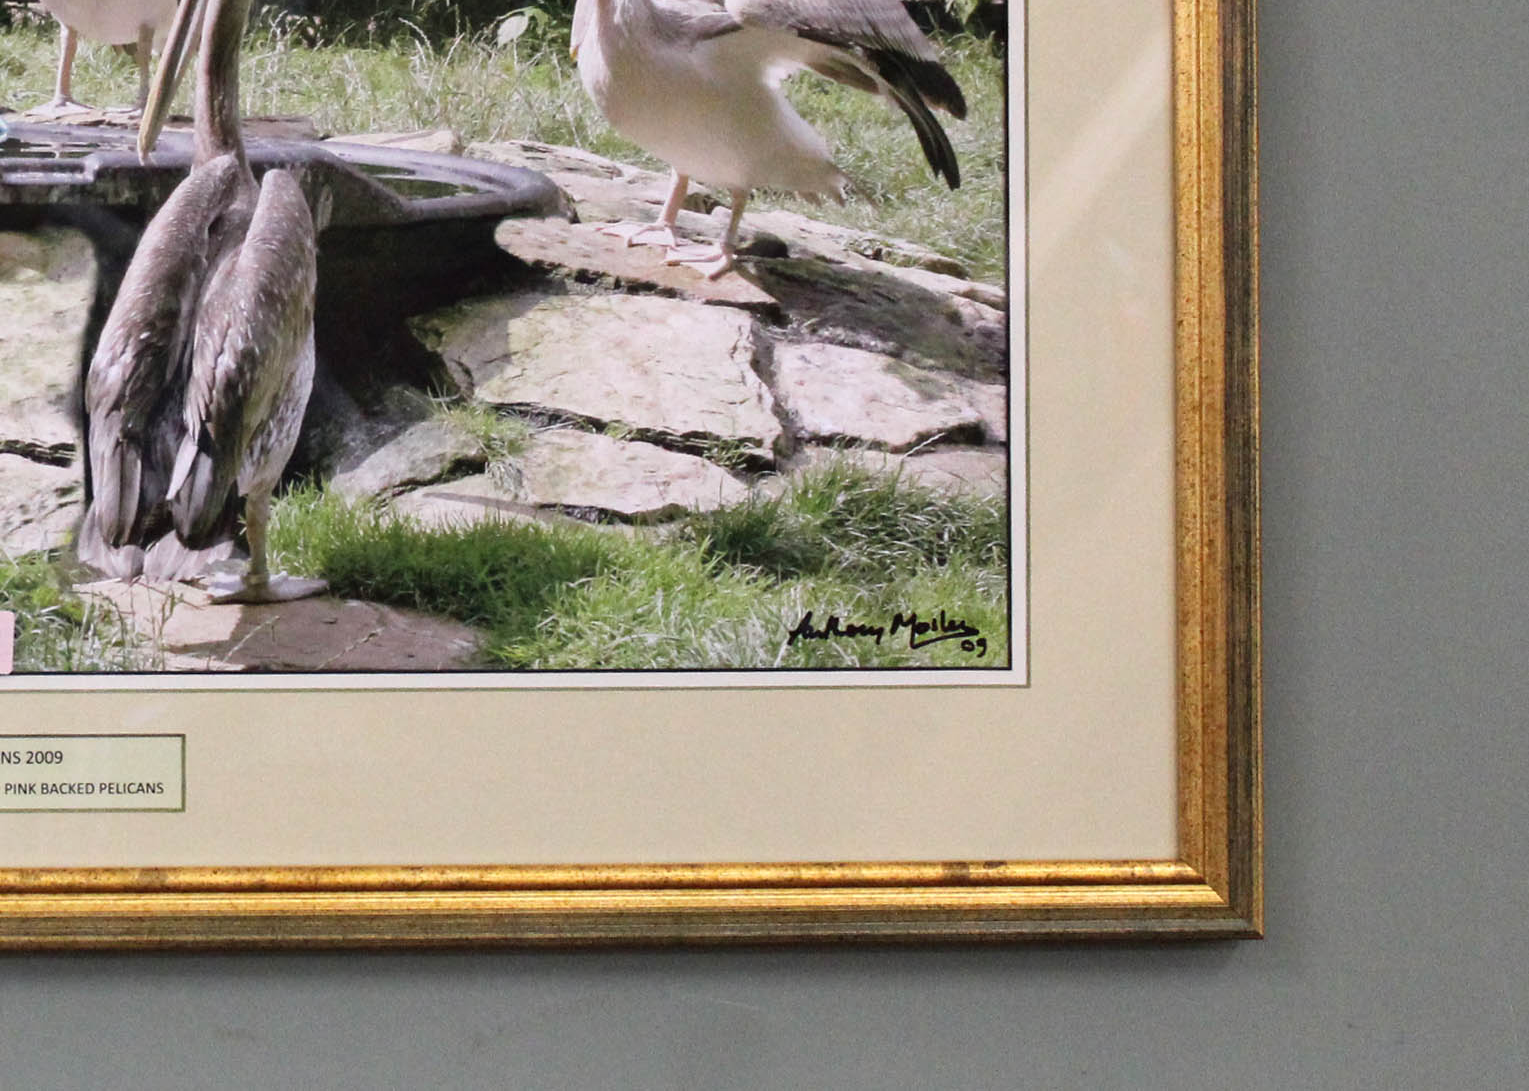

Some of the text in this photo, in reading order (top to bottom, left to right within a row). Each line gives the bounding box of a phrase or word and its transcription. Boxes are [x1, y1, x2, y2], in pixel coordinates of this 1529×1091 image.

[960, 636, 988, 658] 09
[25, 750, 64, 765] 2009
[4, 782, 37, 795] PINK
[40, 782, 95, 795] BACKED
[99, 782, 164, 795] PELICANS
